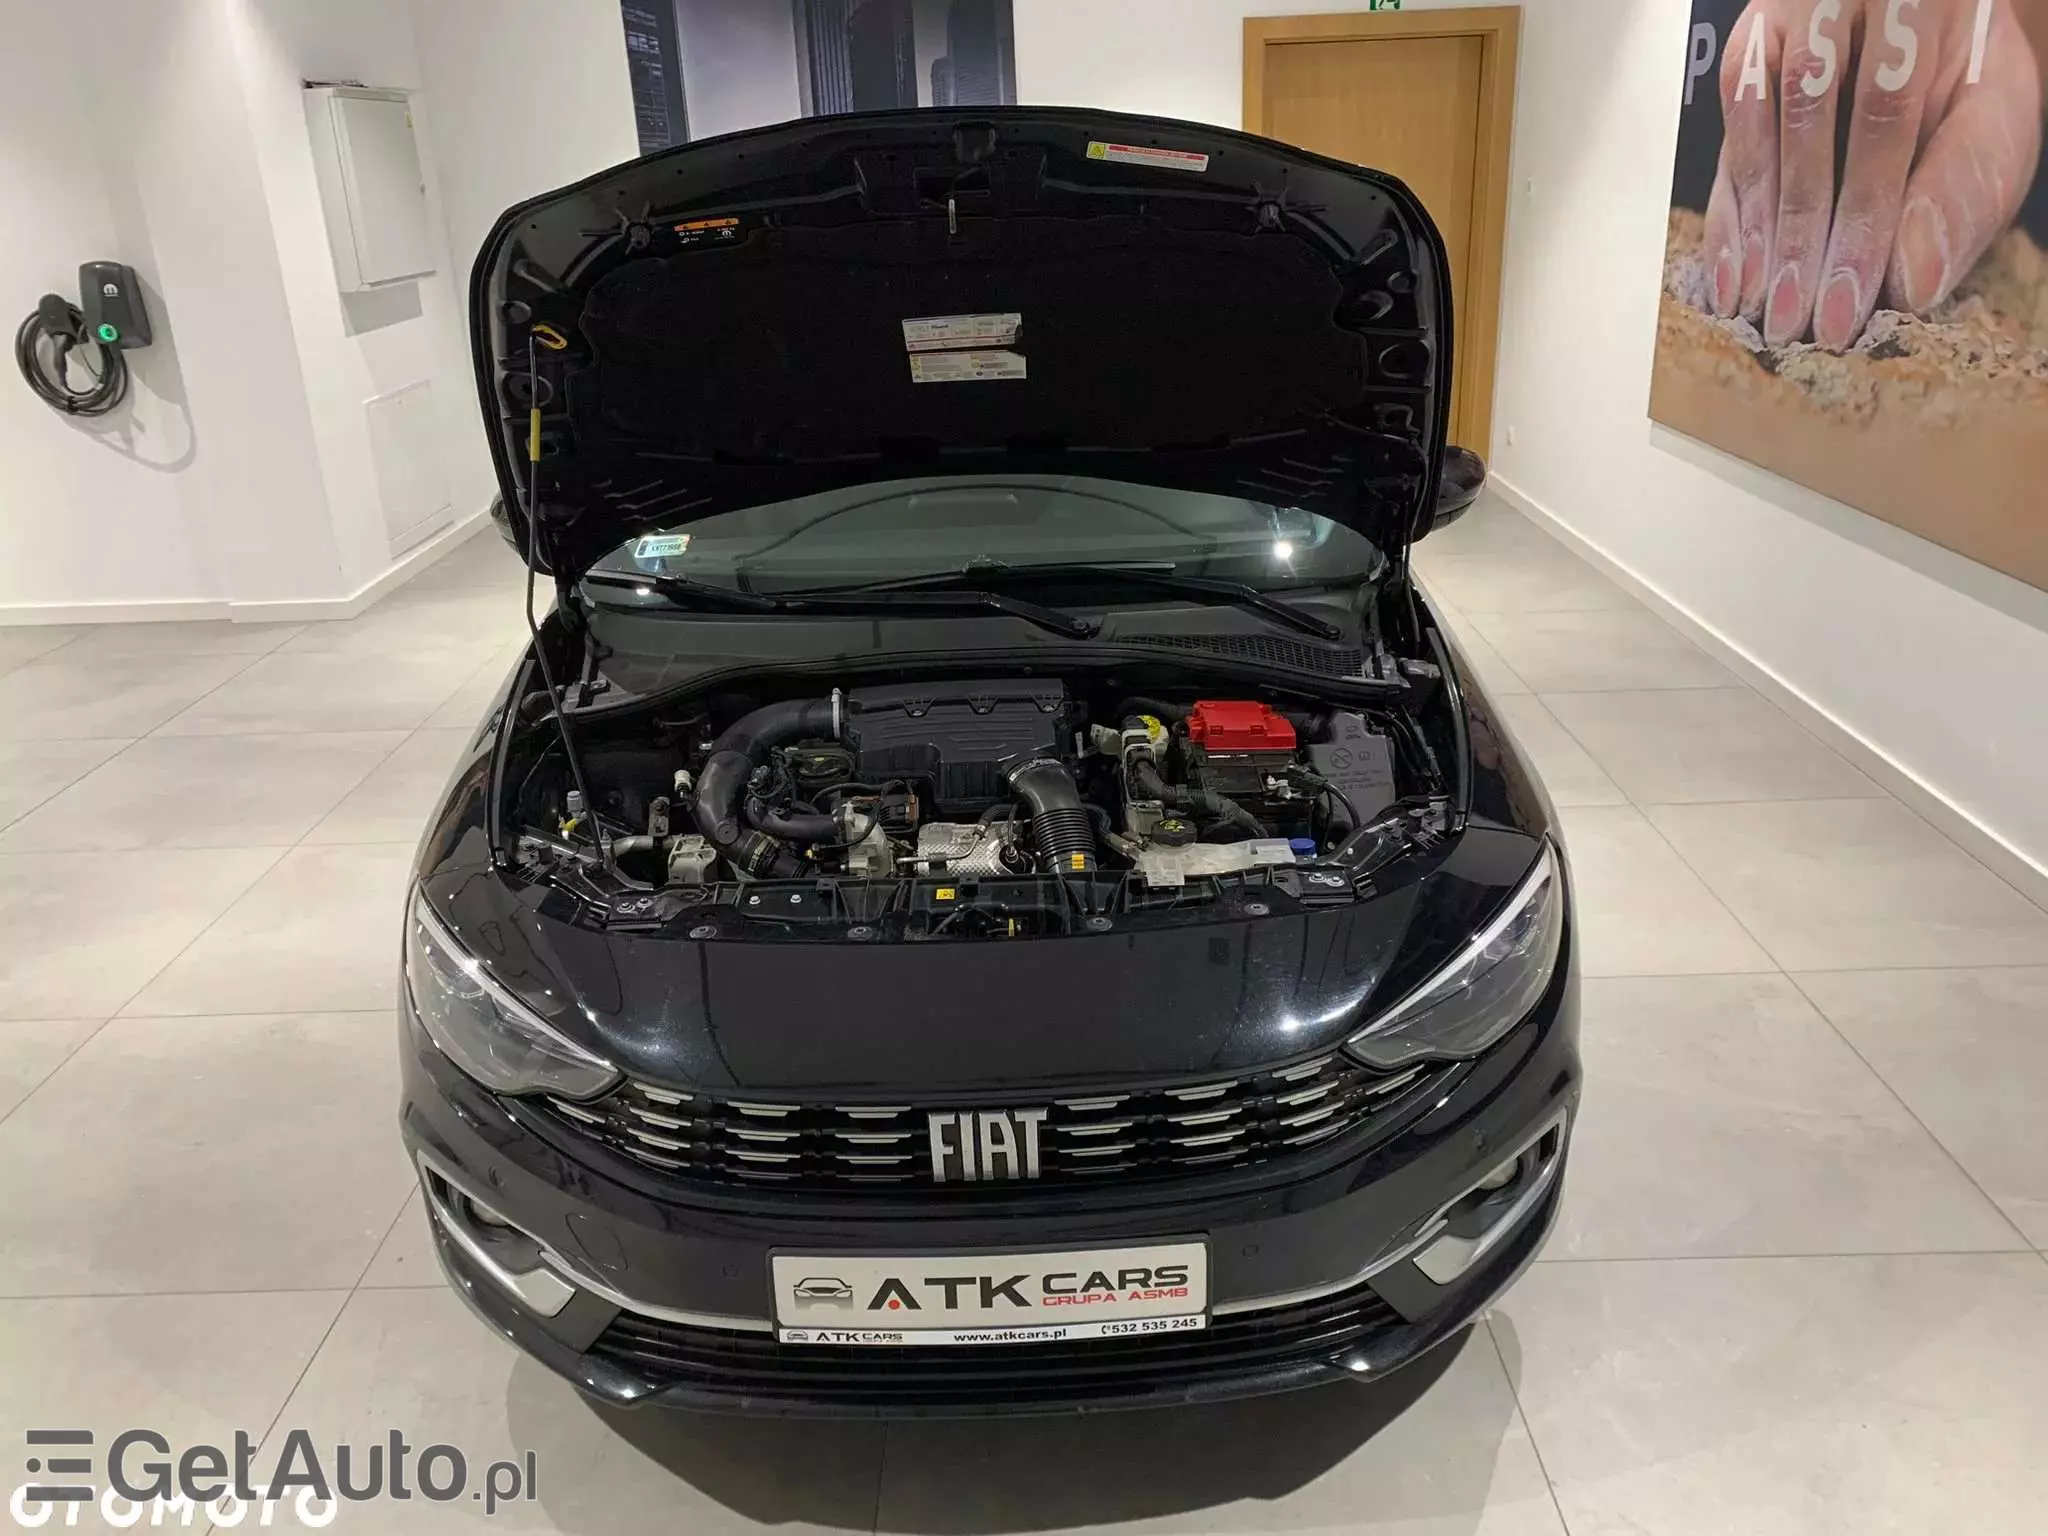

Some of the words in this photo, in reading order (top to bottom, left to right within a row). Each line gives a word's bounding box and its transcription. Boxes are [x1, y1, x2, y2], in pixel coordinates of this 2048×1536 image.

[928, 1107, 1048, 1182] FIAT
[867, 1275, 1033, 1310] ATK
[1042, 1265, 1188, 1294] CARS
[1042, 1293, 1117, 1307] GRUPA
[1127, 1287, 1188, 1301] ASMB
[1111, 1323, 1137, 1334] 532
[1142, 1321, 1167, 1331] 535
[1172, 1317, 1198, 1328] 245
[816, 1332, 860, 1343] ATK
[862, 1332, 903, 1341] CARS
[954, 1328, 1067, 1343] www.atkcars.pl
